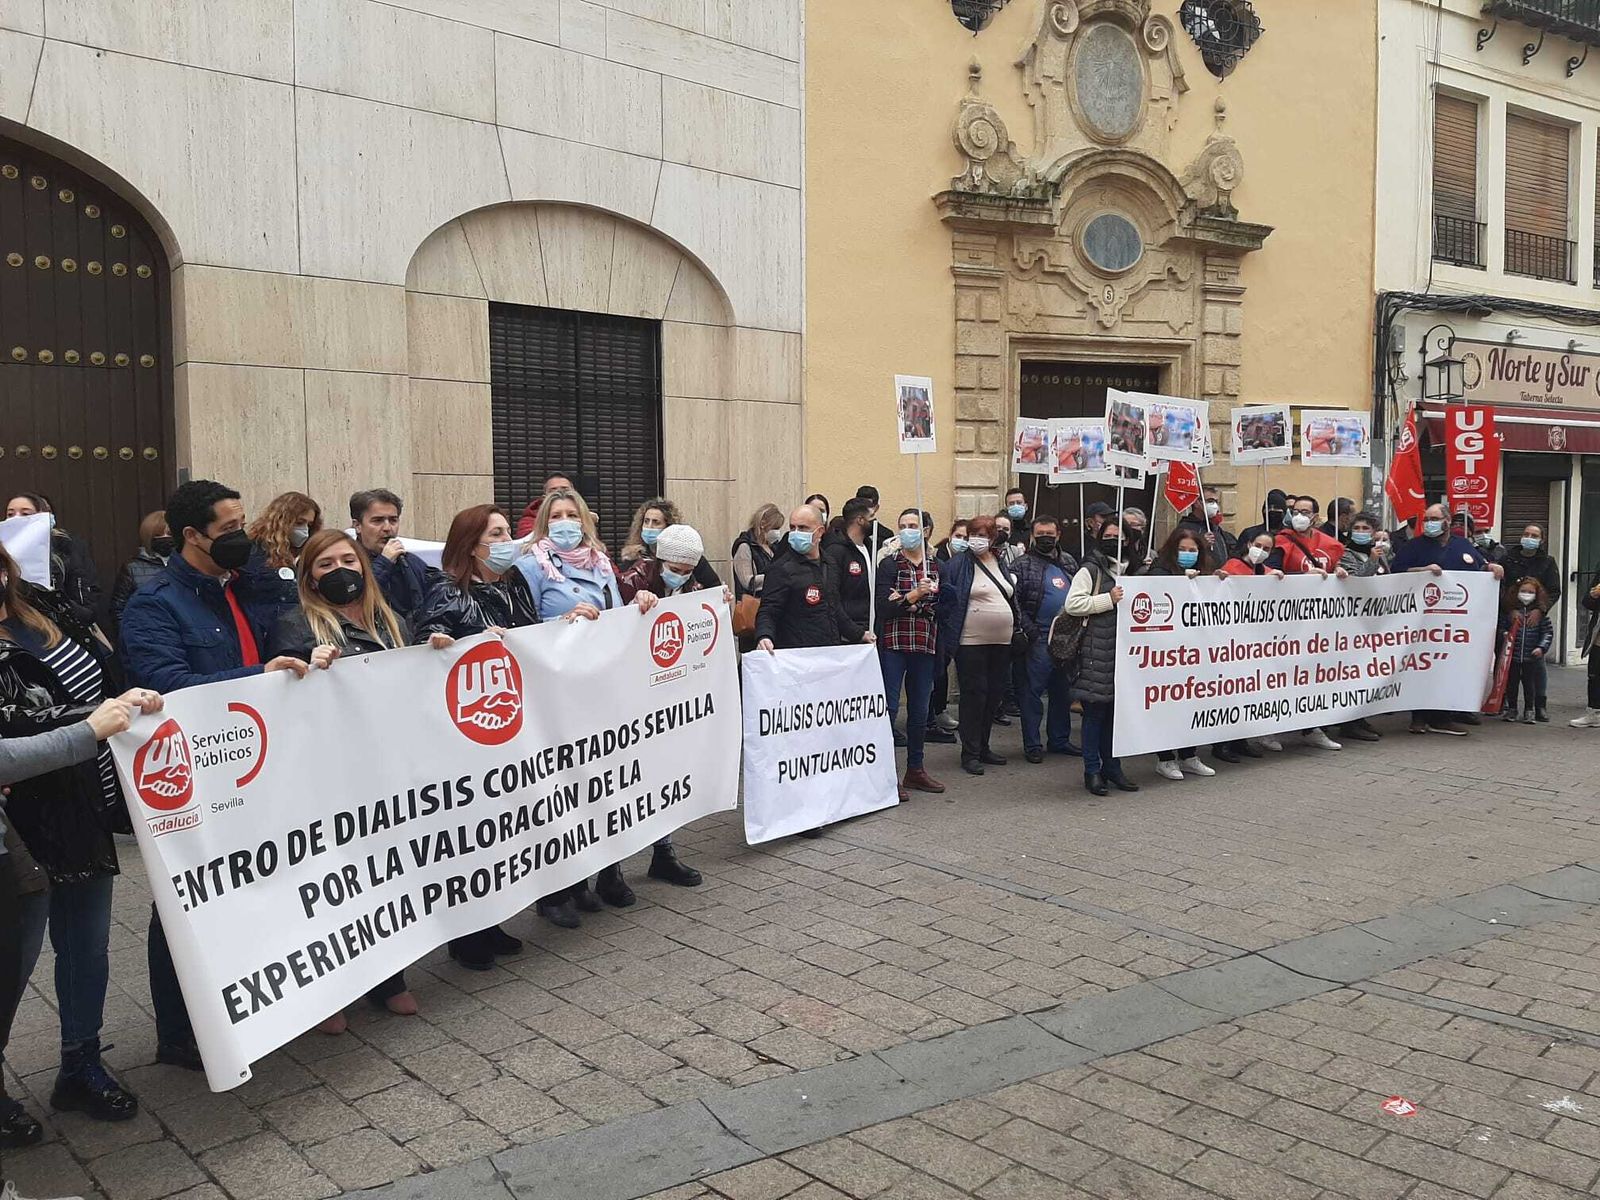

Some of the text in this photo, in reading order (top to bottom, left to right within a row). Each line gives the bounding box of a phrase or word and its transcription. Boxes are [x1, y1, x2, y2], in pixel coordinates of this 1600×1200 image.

[1488, 348, 1541, 383] Norte
[1545, 363, 1556, 392] y
[1558, 355, 1590, 387] Sur
[1455, 411, 1484, 475] UGT
[687, 619, 713, 632] Servicios
[1181, 588, 1417, 627] CENTROS DIÁLISIS CONCERTADOS DE ANDALUCÍA
[654, 619, 680, 648] UGT
[687, 631, 712, 644] Públicos
[1129, 624, 1470, 669] “Justa valoración de la experiencia
[1144, 669, 1260, 710] profesional
[1266, 672, 1287, 689] en
[1294, 665, 1308, 686] la
[1316, 661, 1360, 684] bolsa
[1367, 655, 1395, 678] del
[759, 701, 813, 736] DIÁLISIS
[1191, 706, 1240, 729] MISMO
[1244, 699, 1292, 722] TRABAJO,
[1295, 692, 1328, 715] IGUAL
[192, 724, 254, 750] Servicios
[194, 746, 252, 770] Públicos
[778, 743, 876, 783] PUNTUAMOS
[287, 820, 327, 867] DE
[334, 775, 475, 847] DIALISIS
[483, 718, 641, 798] CONCERTADOS
[644, 693, 715, 739] SEVILLA
[210, 797, 244, 813] Sevilla
[298, 759, 642, 919] POR LA VALORACIÓN DE LA
[221, 774, 692, 1025] EXPERIENCIA PROFESIONAL EN EL SAS
